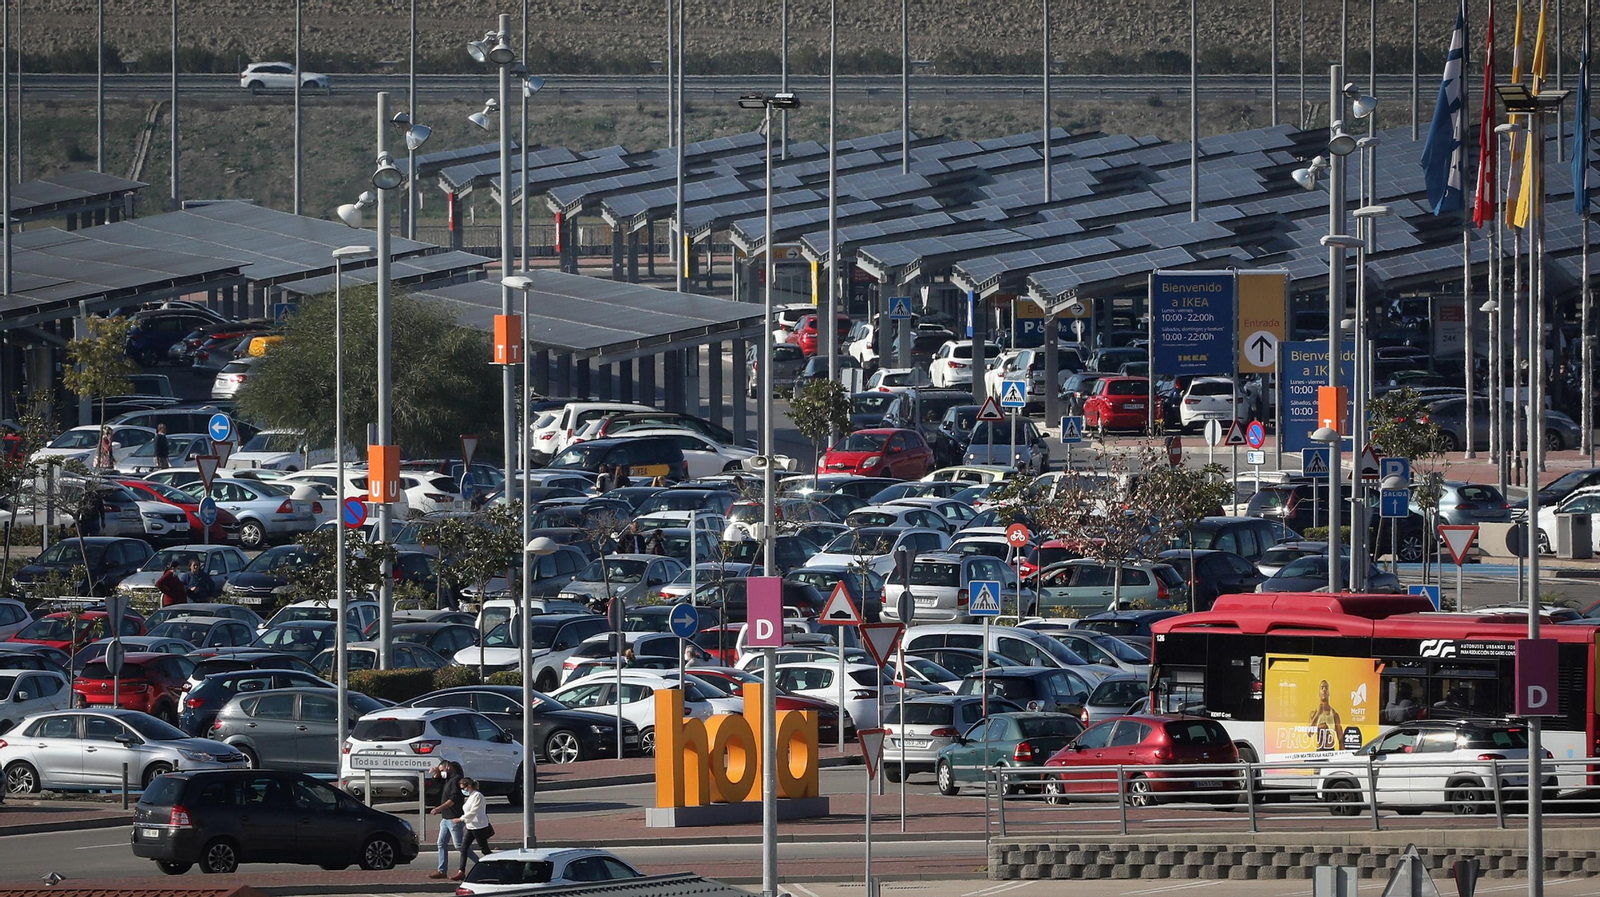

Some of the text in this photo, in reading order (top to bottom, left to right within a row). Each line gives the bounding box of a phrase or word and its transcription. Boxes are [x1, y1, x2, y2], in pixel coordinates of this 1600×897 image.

[1162, 282, 1222, 292] Bienvenido
[1172, 297, 1209, 307] a IKEA
[1188, 314, 1214, 322] 22:00h
[1024, 322, 1034, 334] P
[1244, 319, 1280, 328] Entrada
[497, 344, 518, 360] T T
[1291, 350, 1356, 361] Bienveido
[1302, 367, 1310, 376] a
[1290, 386, 1314, 394] 10:00
[1290, 408, 1314, 416] 10:00
[372, 480, 396, 498] U U
[756, 618, 774, 640] D
[1528, 686, 1548, 708] D
[1276, 728, 1337, 750] PROUD
[354, 758, 432, 767] Todas direcciones
